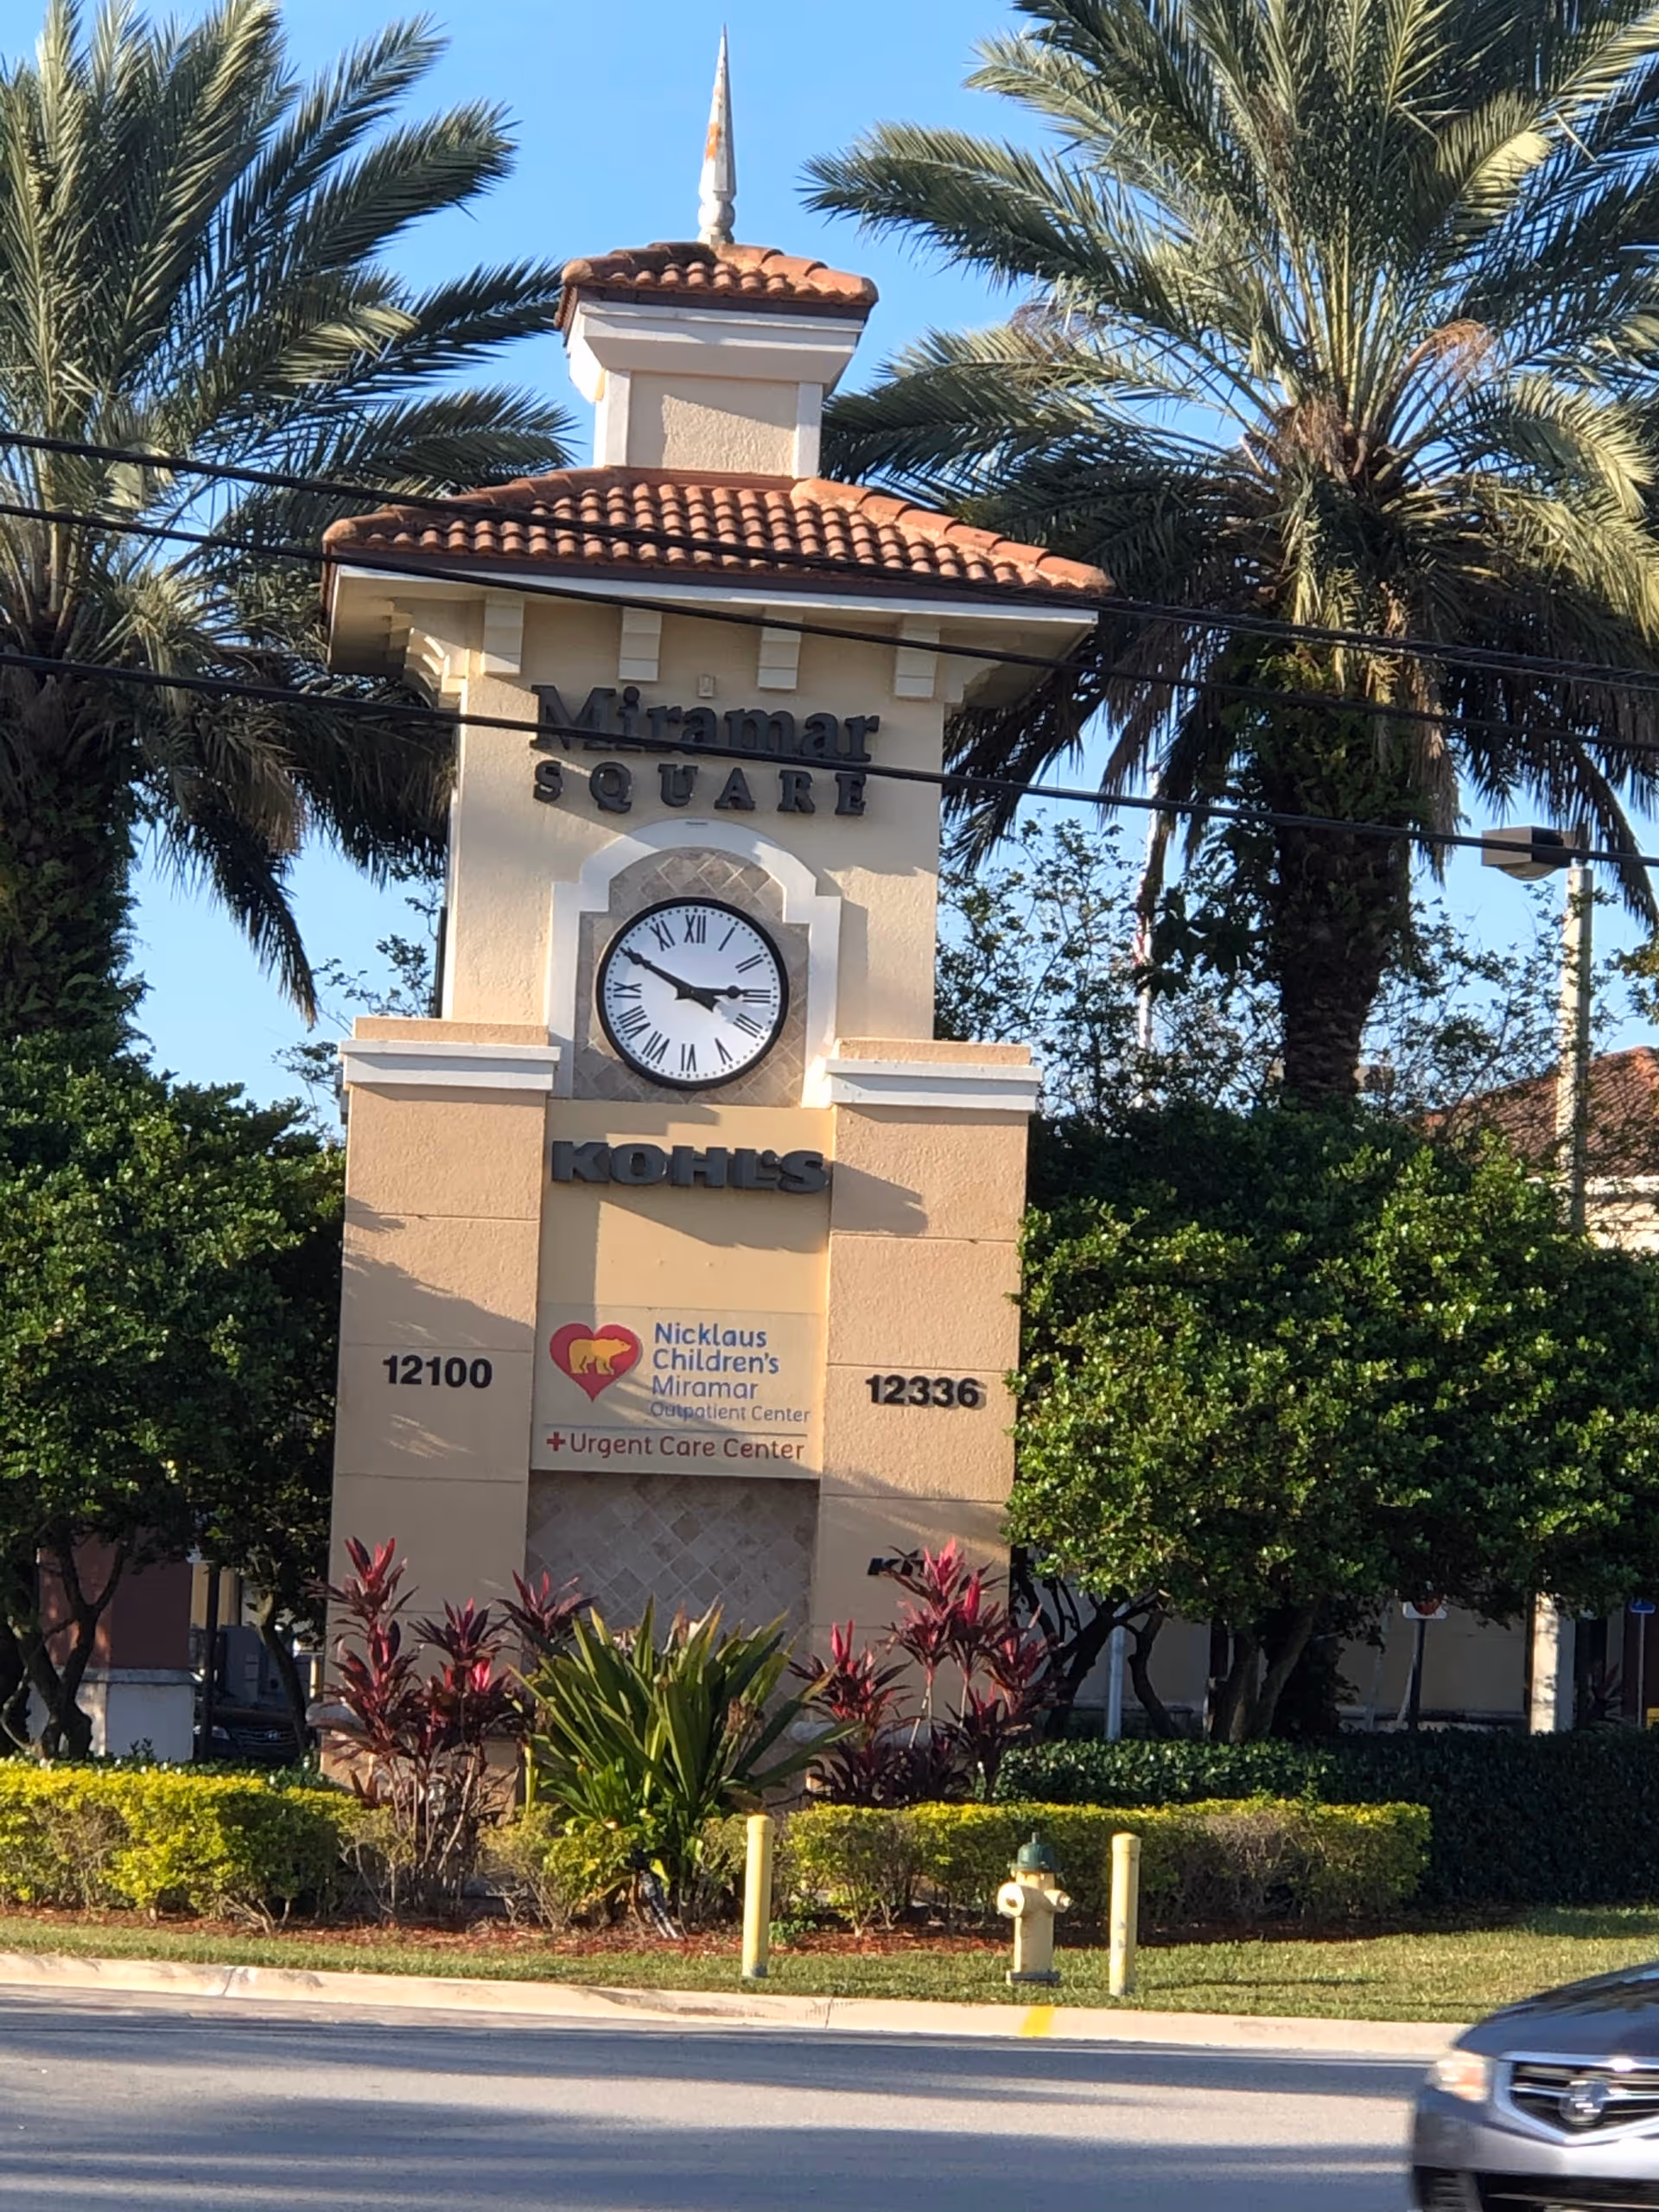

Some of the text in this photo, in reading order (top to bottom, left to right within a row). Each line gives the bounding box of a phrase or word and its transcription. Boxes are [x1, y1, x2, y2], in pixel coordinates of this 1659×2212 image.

[531, 684, 880, 763] Miramar
[533, 760, 868, 816] SQUARE
[654, 1322, 768, 1348] Nicklaus
[383, 1355, 493, 1389] 12100
[652, 1348, 780, 1374] Children's
[652, 1375, 759, 1400] Miramar
[866, 1374, 982, 1408] 12336
[650, 1402, 811, 1423] Outpatient Center
[570, 1433, 805, 1460] Urgent Care Center
